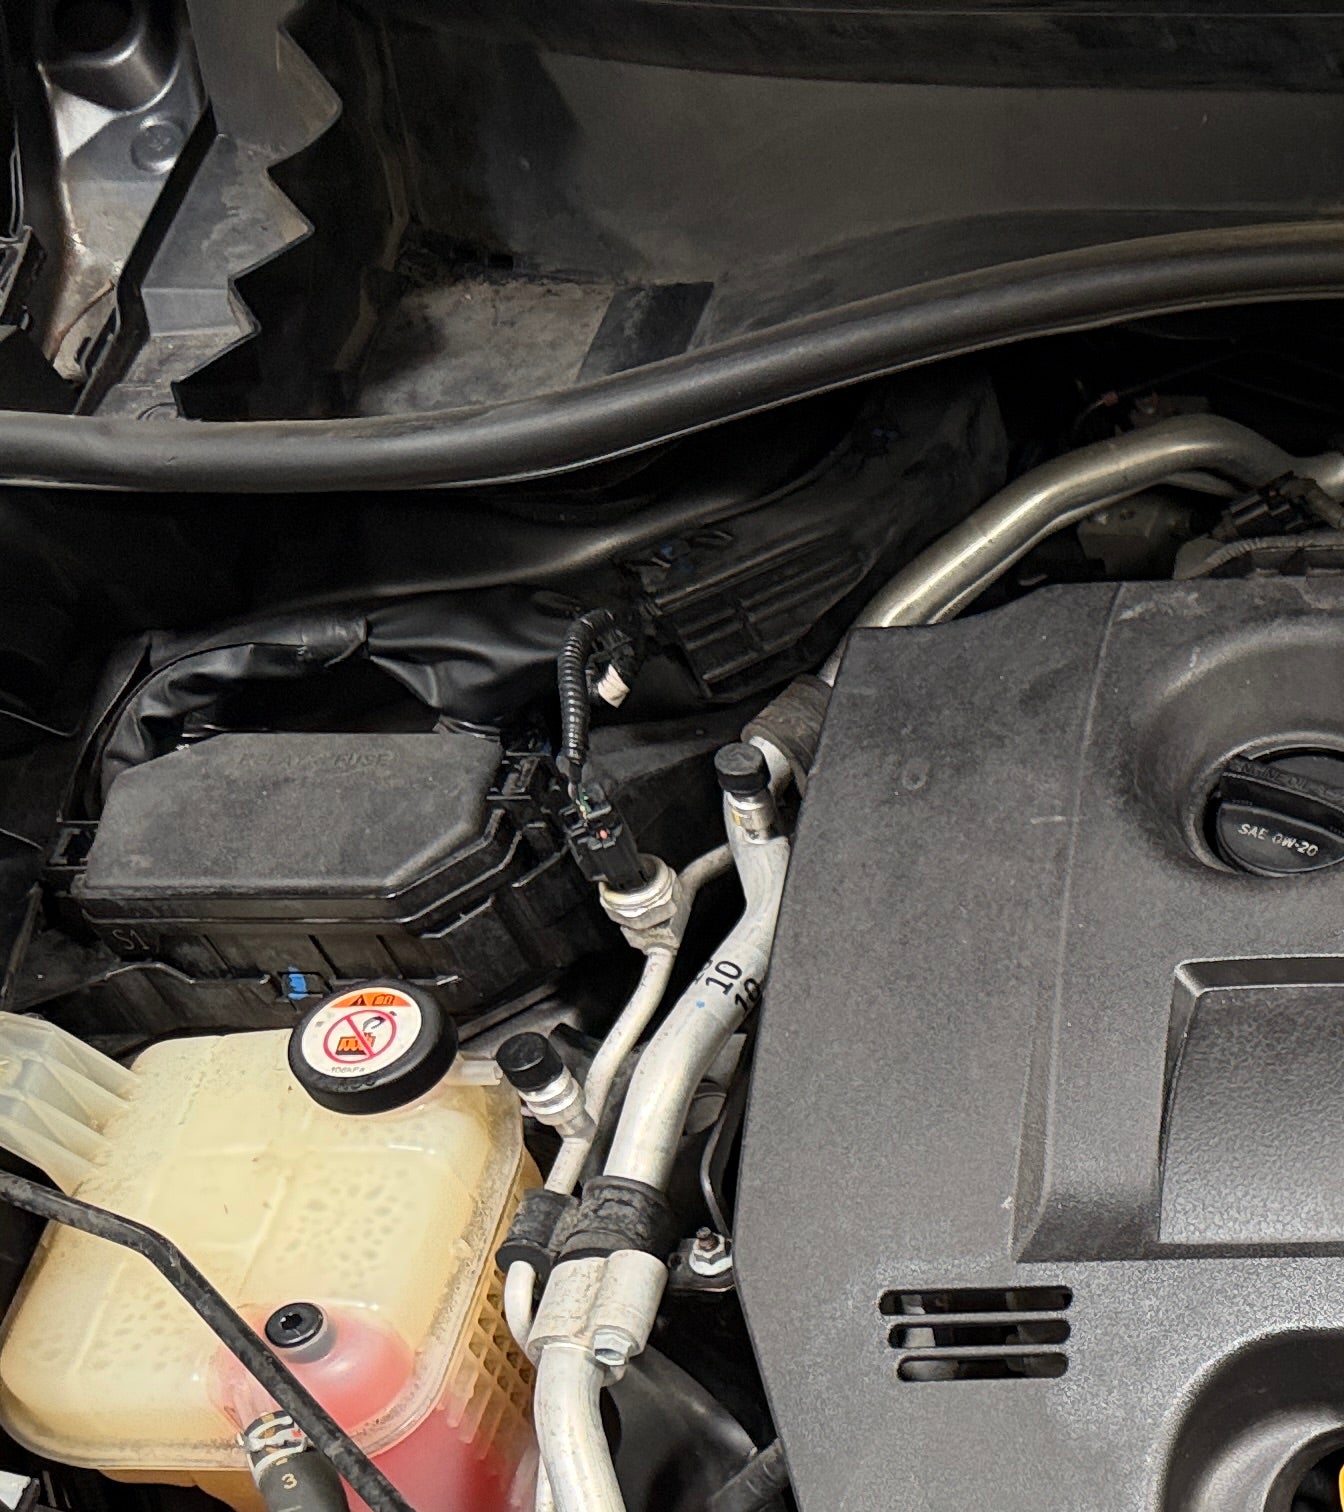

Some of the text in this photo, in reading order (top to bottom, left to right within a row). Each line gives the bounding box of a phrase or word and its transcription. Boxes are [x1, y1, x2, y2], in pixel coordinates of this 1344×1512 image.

[1238, 823, 1319, 857] SAE 0W-20
[705, 960, 743, 996] 10
[281, 1473, 298, 1490] 3
